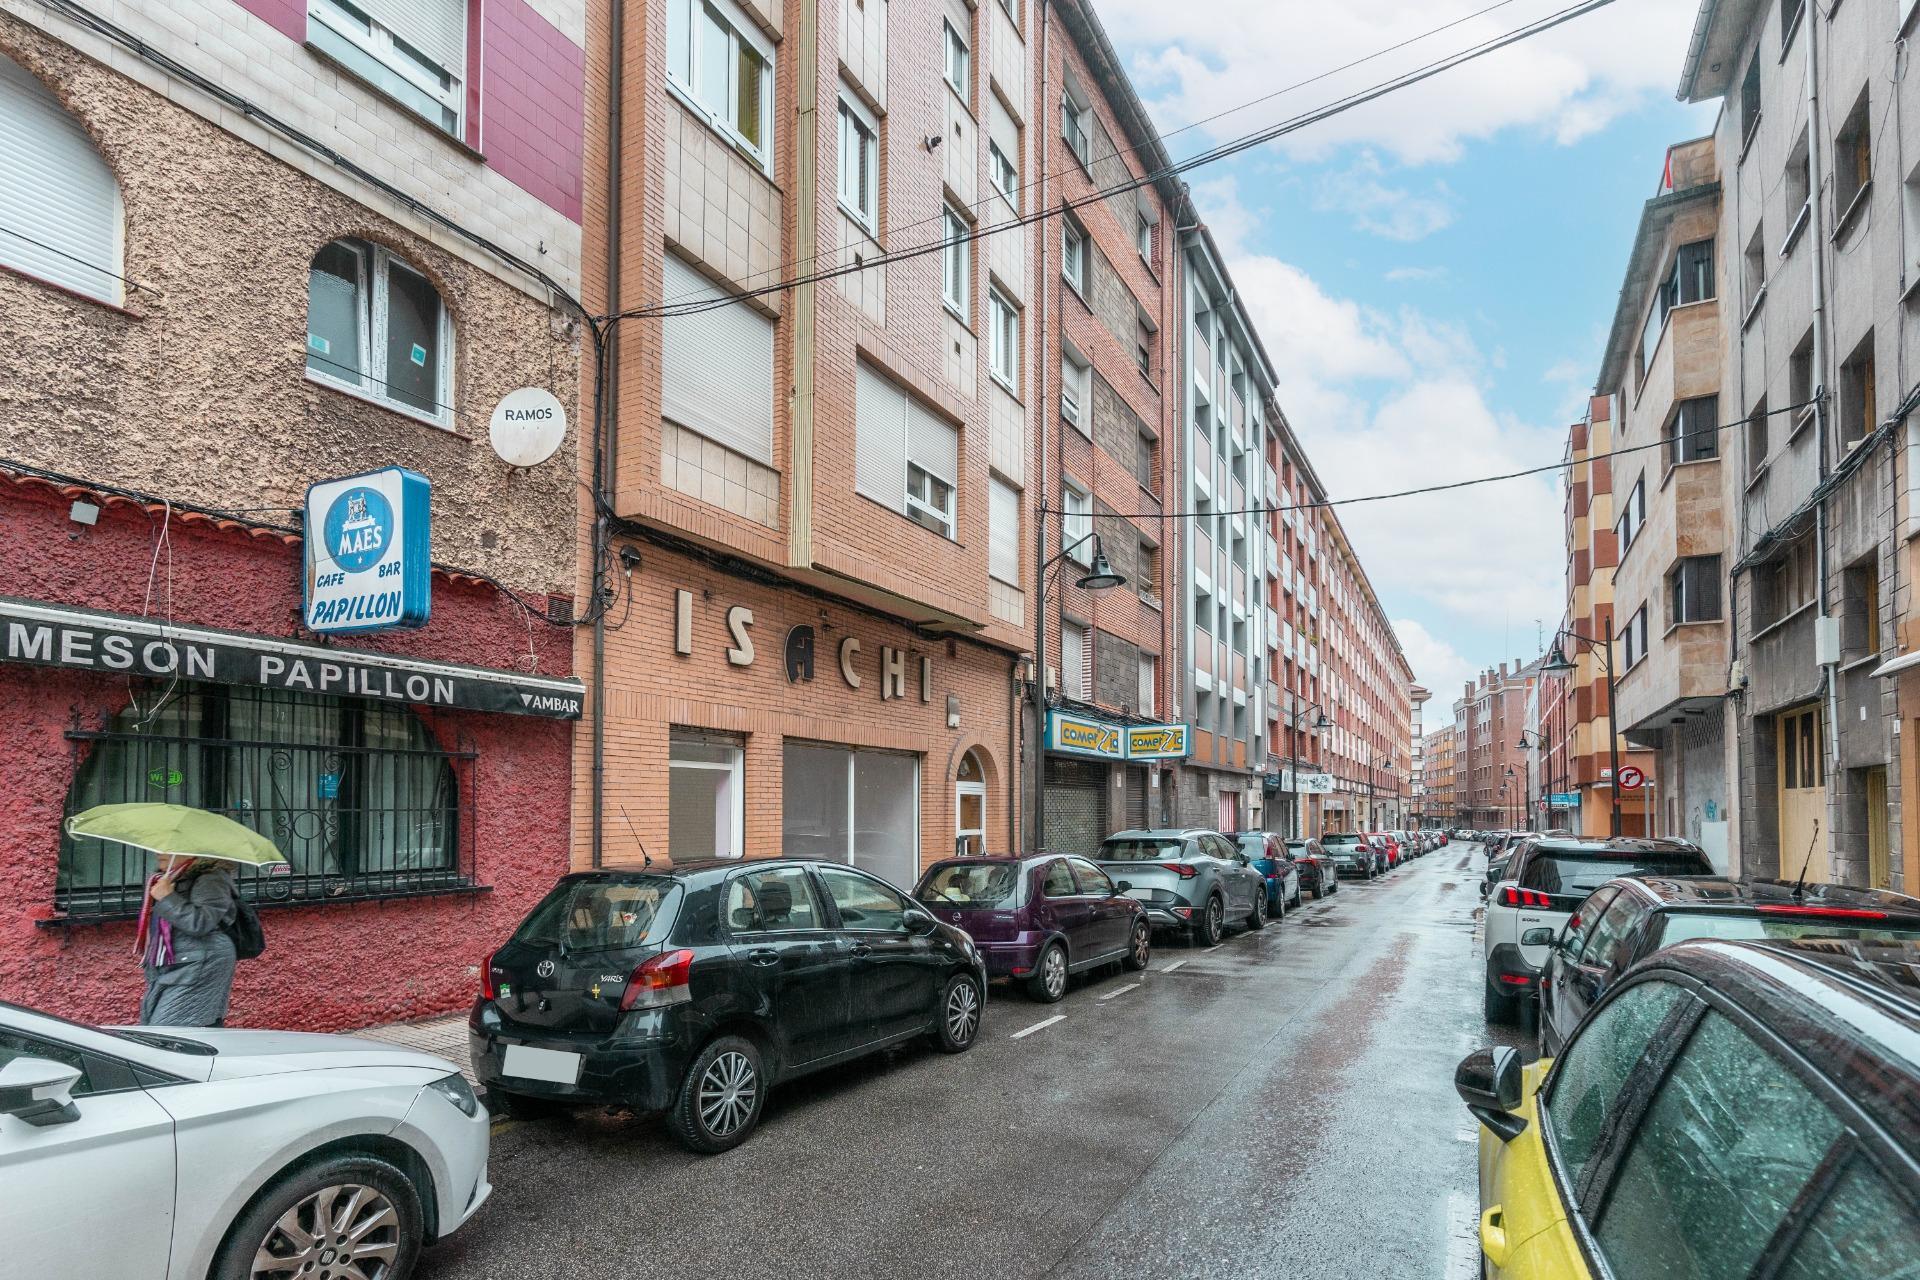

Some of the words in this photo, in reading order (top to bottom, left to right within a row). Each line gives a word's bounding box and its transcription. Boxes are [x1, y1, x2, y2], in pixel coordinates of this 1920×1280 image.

[505, 407, 553, 421] RAMOS
[338, 525, 383, 556] MAES
[316, 572, 346, 588] CAFE
[378, 561, 401, 578] BAR
[311, 590, 402, 625] PAPILLON
[8, 622, 215, 678] MESON
[259, 655, 454, 705] PAPILLON
[532, 695, 580, 713] AMBAR
